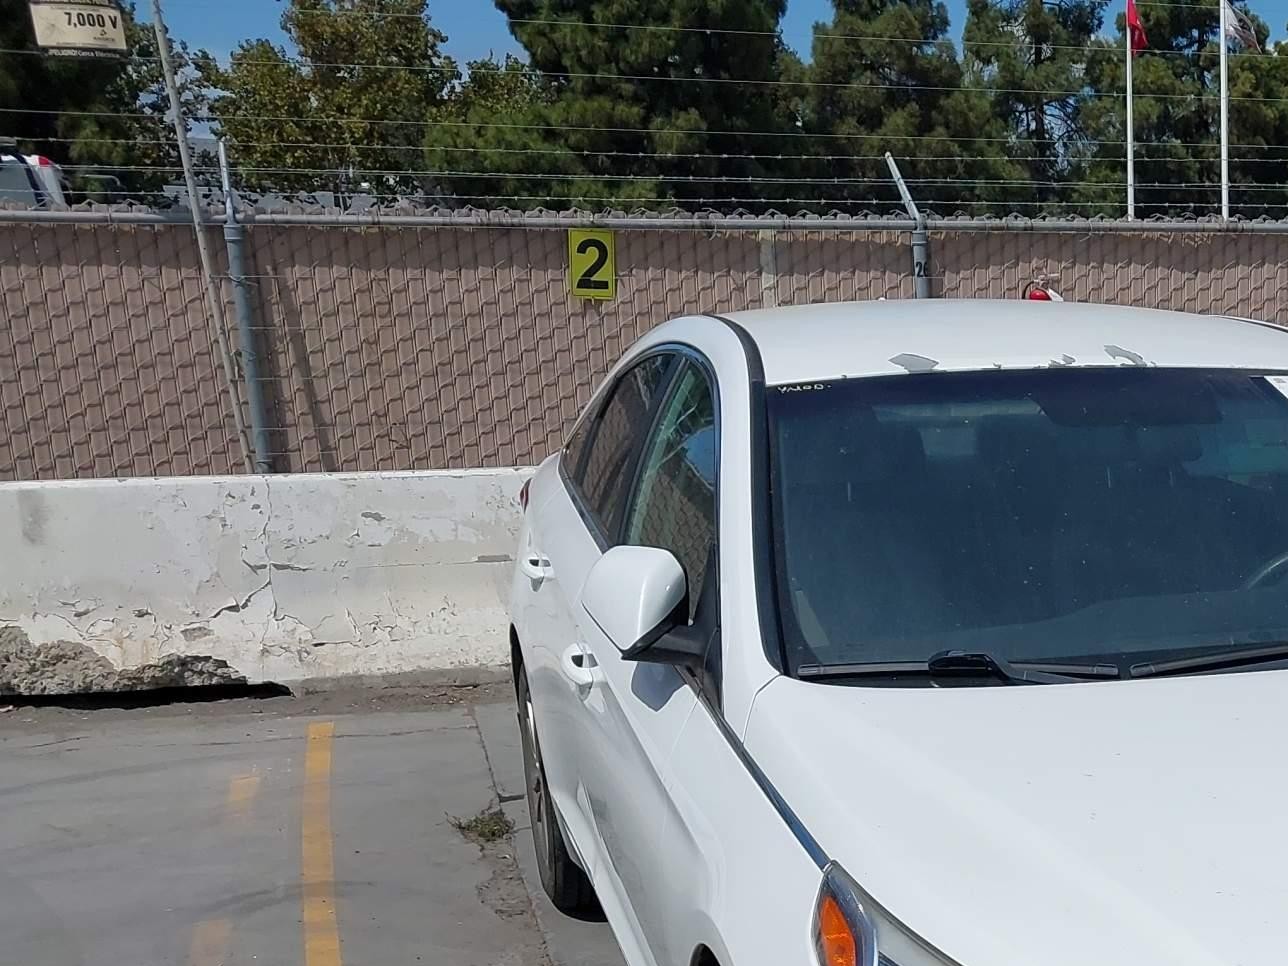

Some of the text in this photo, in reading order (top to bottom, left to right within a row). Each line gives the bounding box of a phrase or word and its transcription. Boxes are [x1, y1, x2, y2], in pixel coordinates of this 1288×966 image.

[64, 12, 117, 29] 7,000 V
[576, 238, 609, 290] 2
